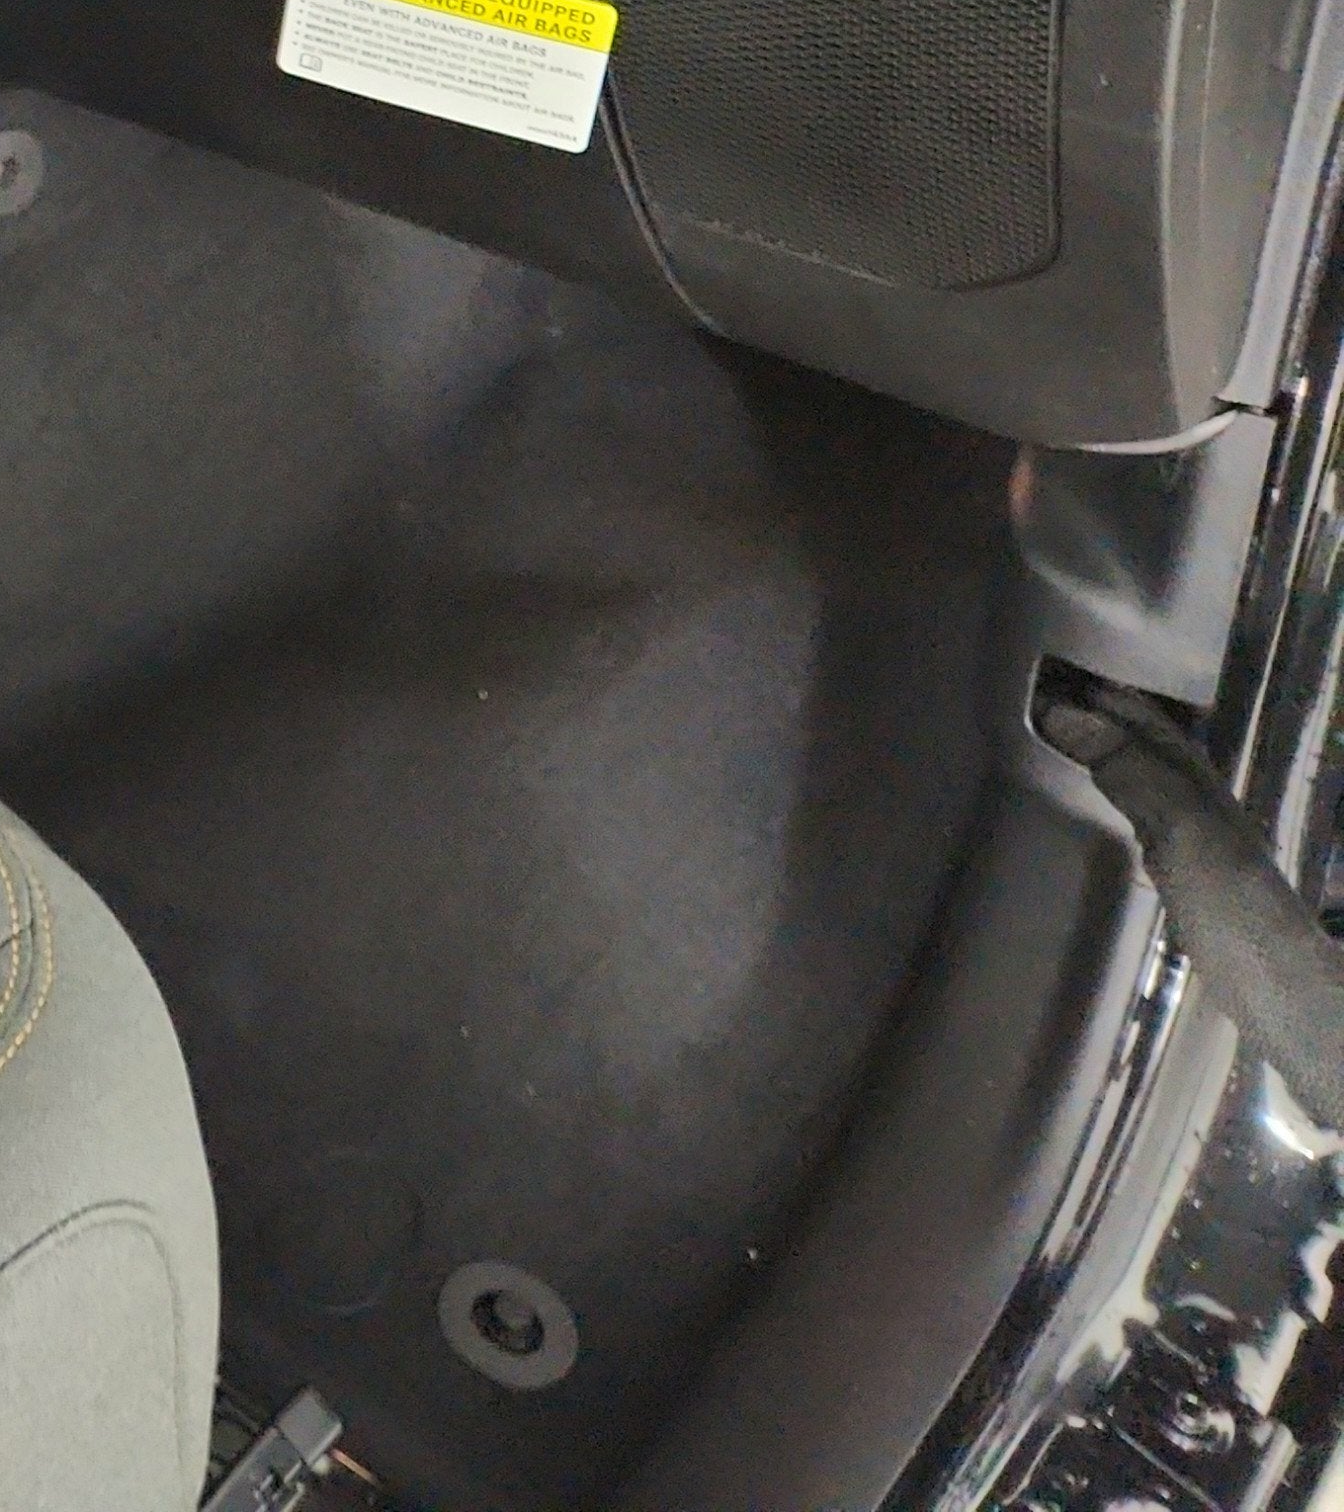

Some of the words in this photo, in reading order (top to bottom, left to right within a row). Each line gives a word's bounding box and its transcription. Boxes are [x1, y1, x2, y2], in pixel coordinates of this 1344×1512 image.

[378, 4, 411, 22] WITH
[413, 14, 484, 42] ADVANCED
[486, 33, 509, 48] AIR
[511, 40, 547, 58] BAGS
[493, 7, 529, 28] AIR
[534, 17, 593, 45] BAGS
